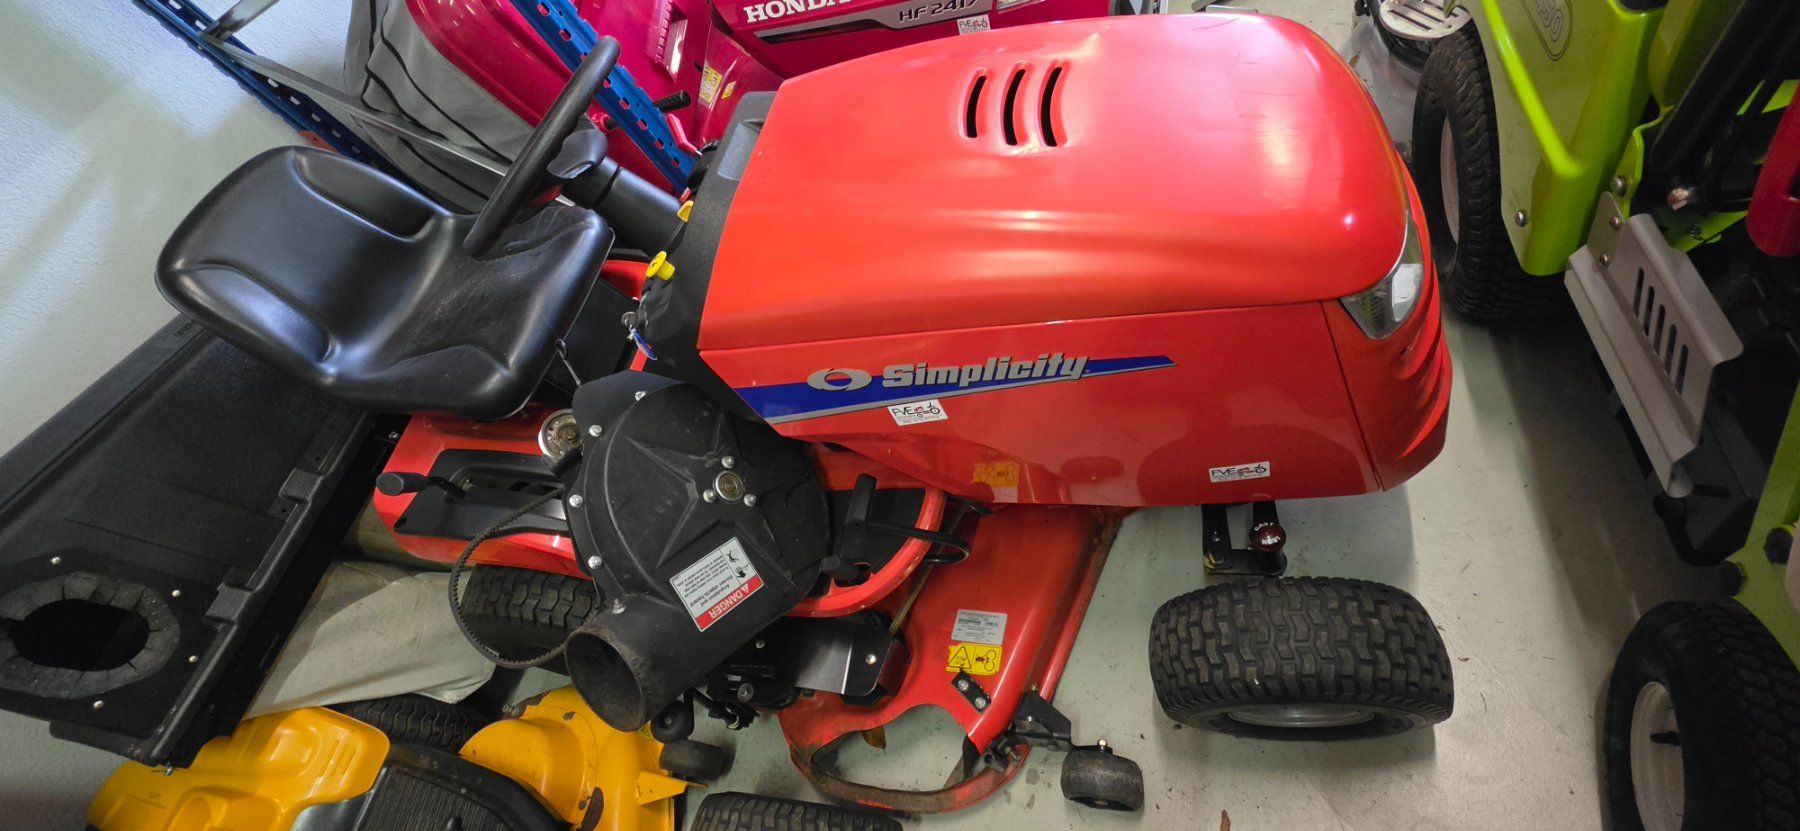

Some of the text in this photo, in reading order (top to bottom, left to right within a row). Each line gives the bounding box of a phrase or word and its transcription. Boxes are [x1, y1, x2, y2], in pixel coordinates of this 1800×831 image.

[899, 4, 928, 23] HF
[882, 352, 1090, 388] Simplicity
[891, 406, 914, 417] FVE
[708, 589, 743, 619] DANGER
